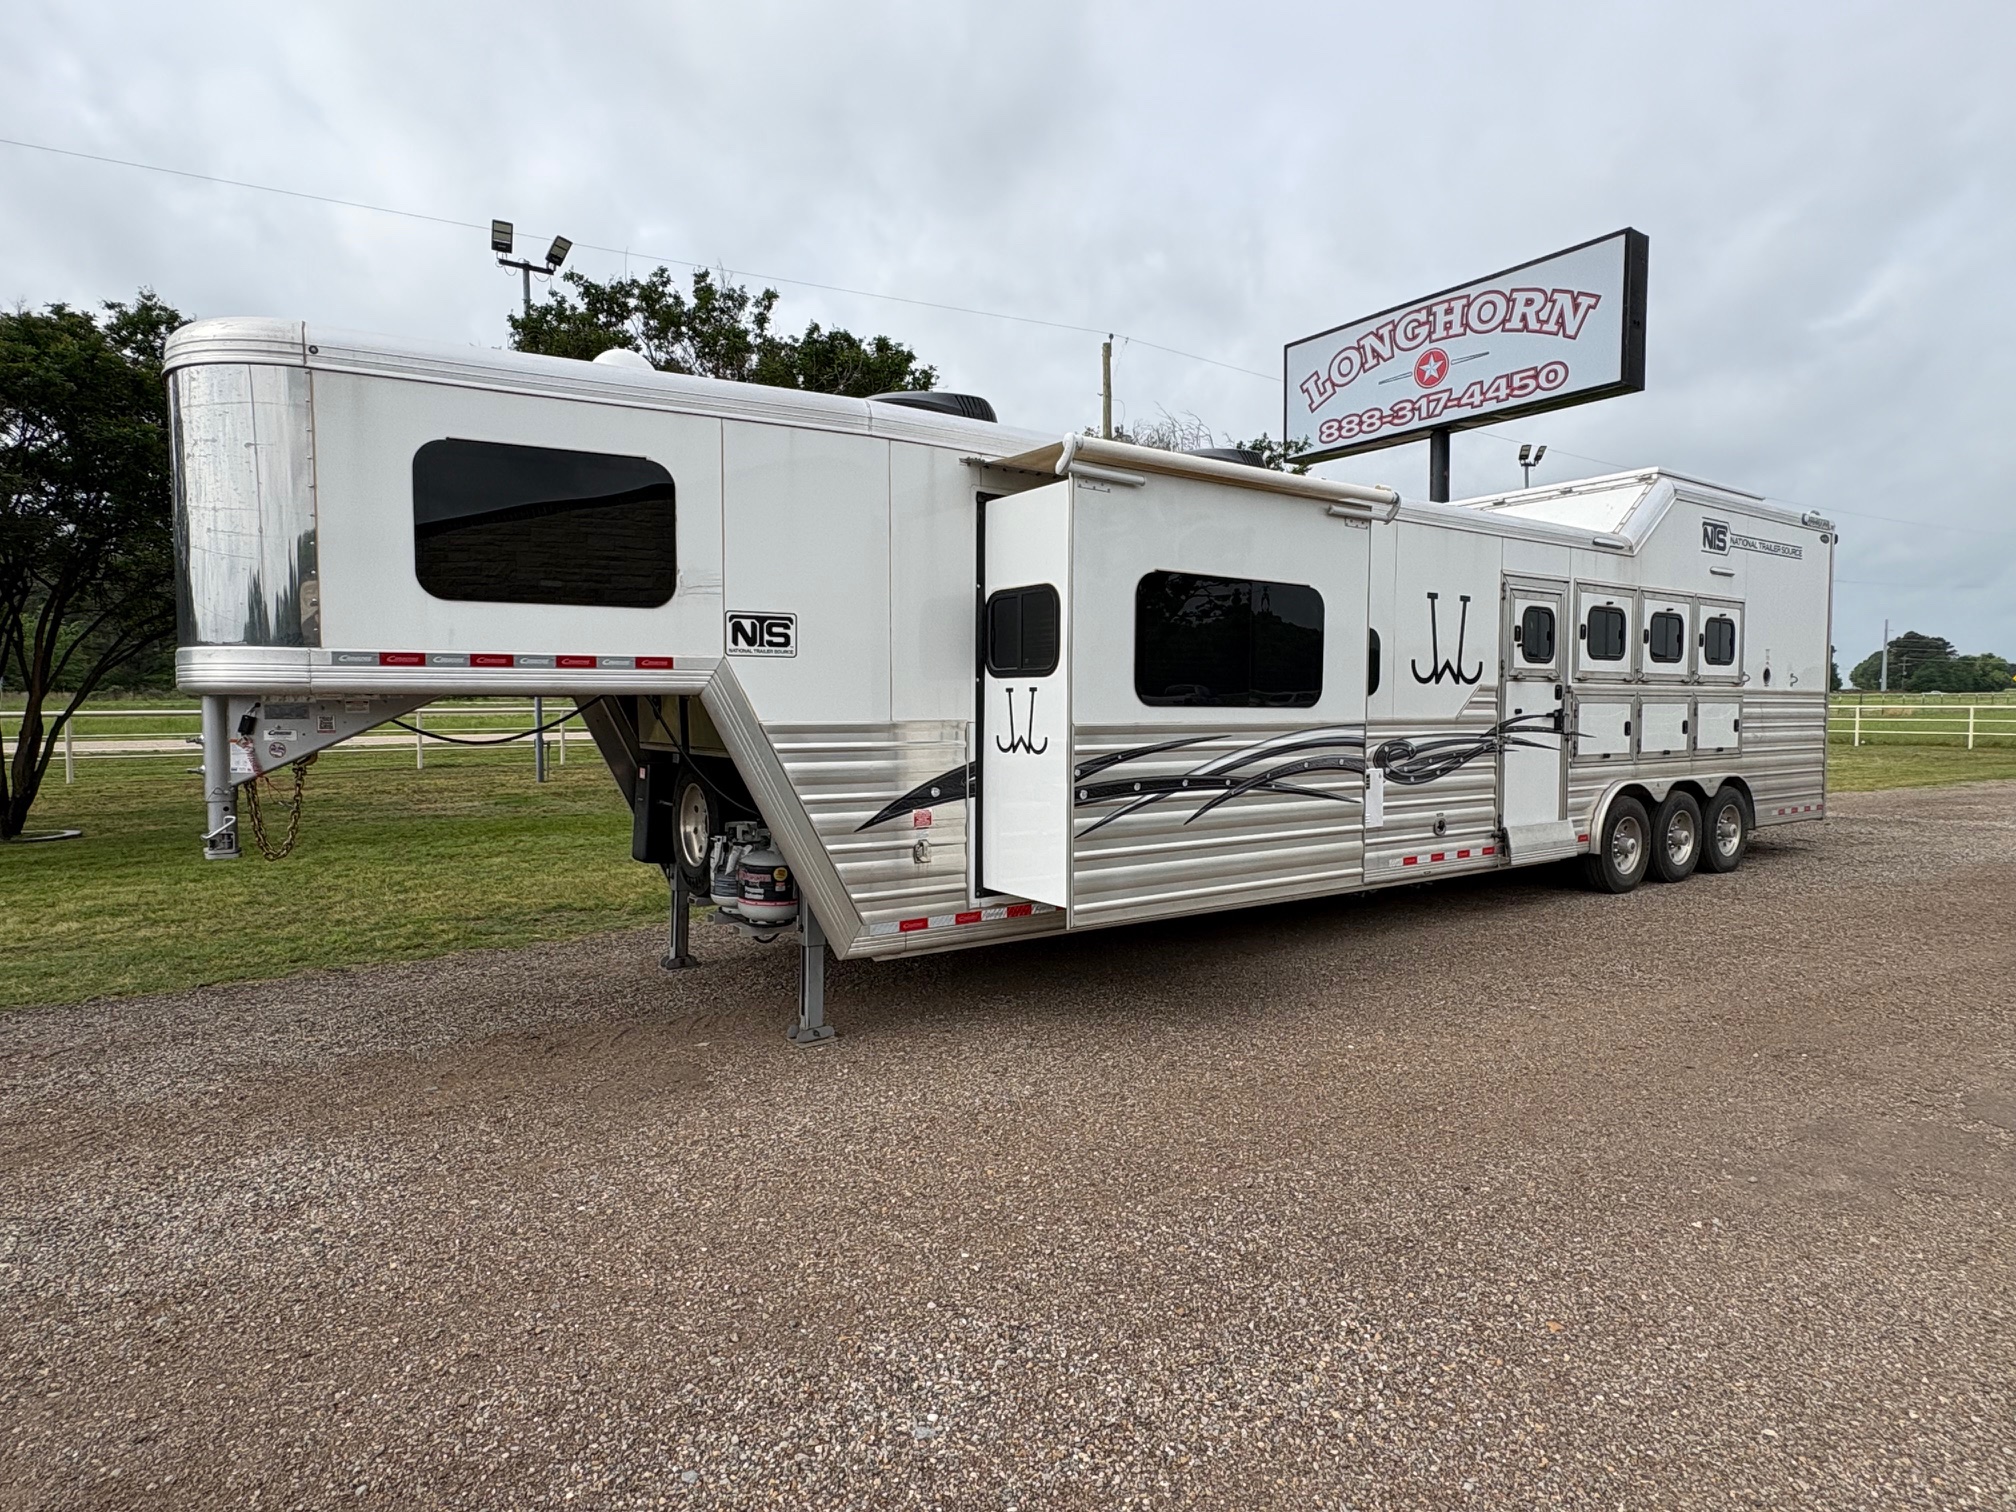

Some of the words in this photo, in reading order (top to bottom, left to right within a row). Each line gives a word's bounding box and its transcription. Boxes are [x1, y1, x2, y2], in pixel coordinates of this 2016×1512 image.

[1300, 288, 1602, 412] LONGHORN
[1318, 360, 1570, 444] 888-317-4450
[1702, 521, 1728, 551] NTS
[1730, 536, 1758, 549] NATIONAL
[1759, 542, 1781, 552] TRAILER
[1782, 546, 1803, 557] SOURCE
[728, 614, 794, 648] NTS
